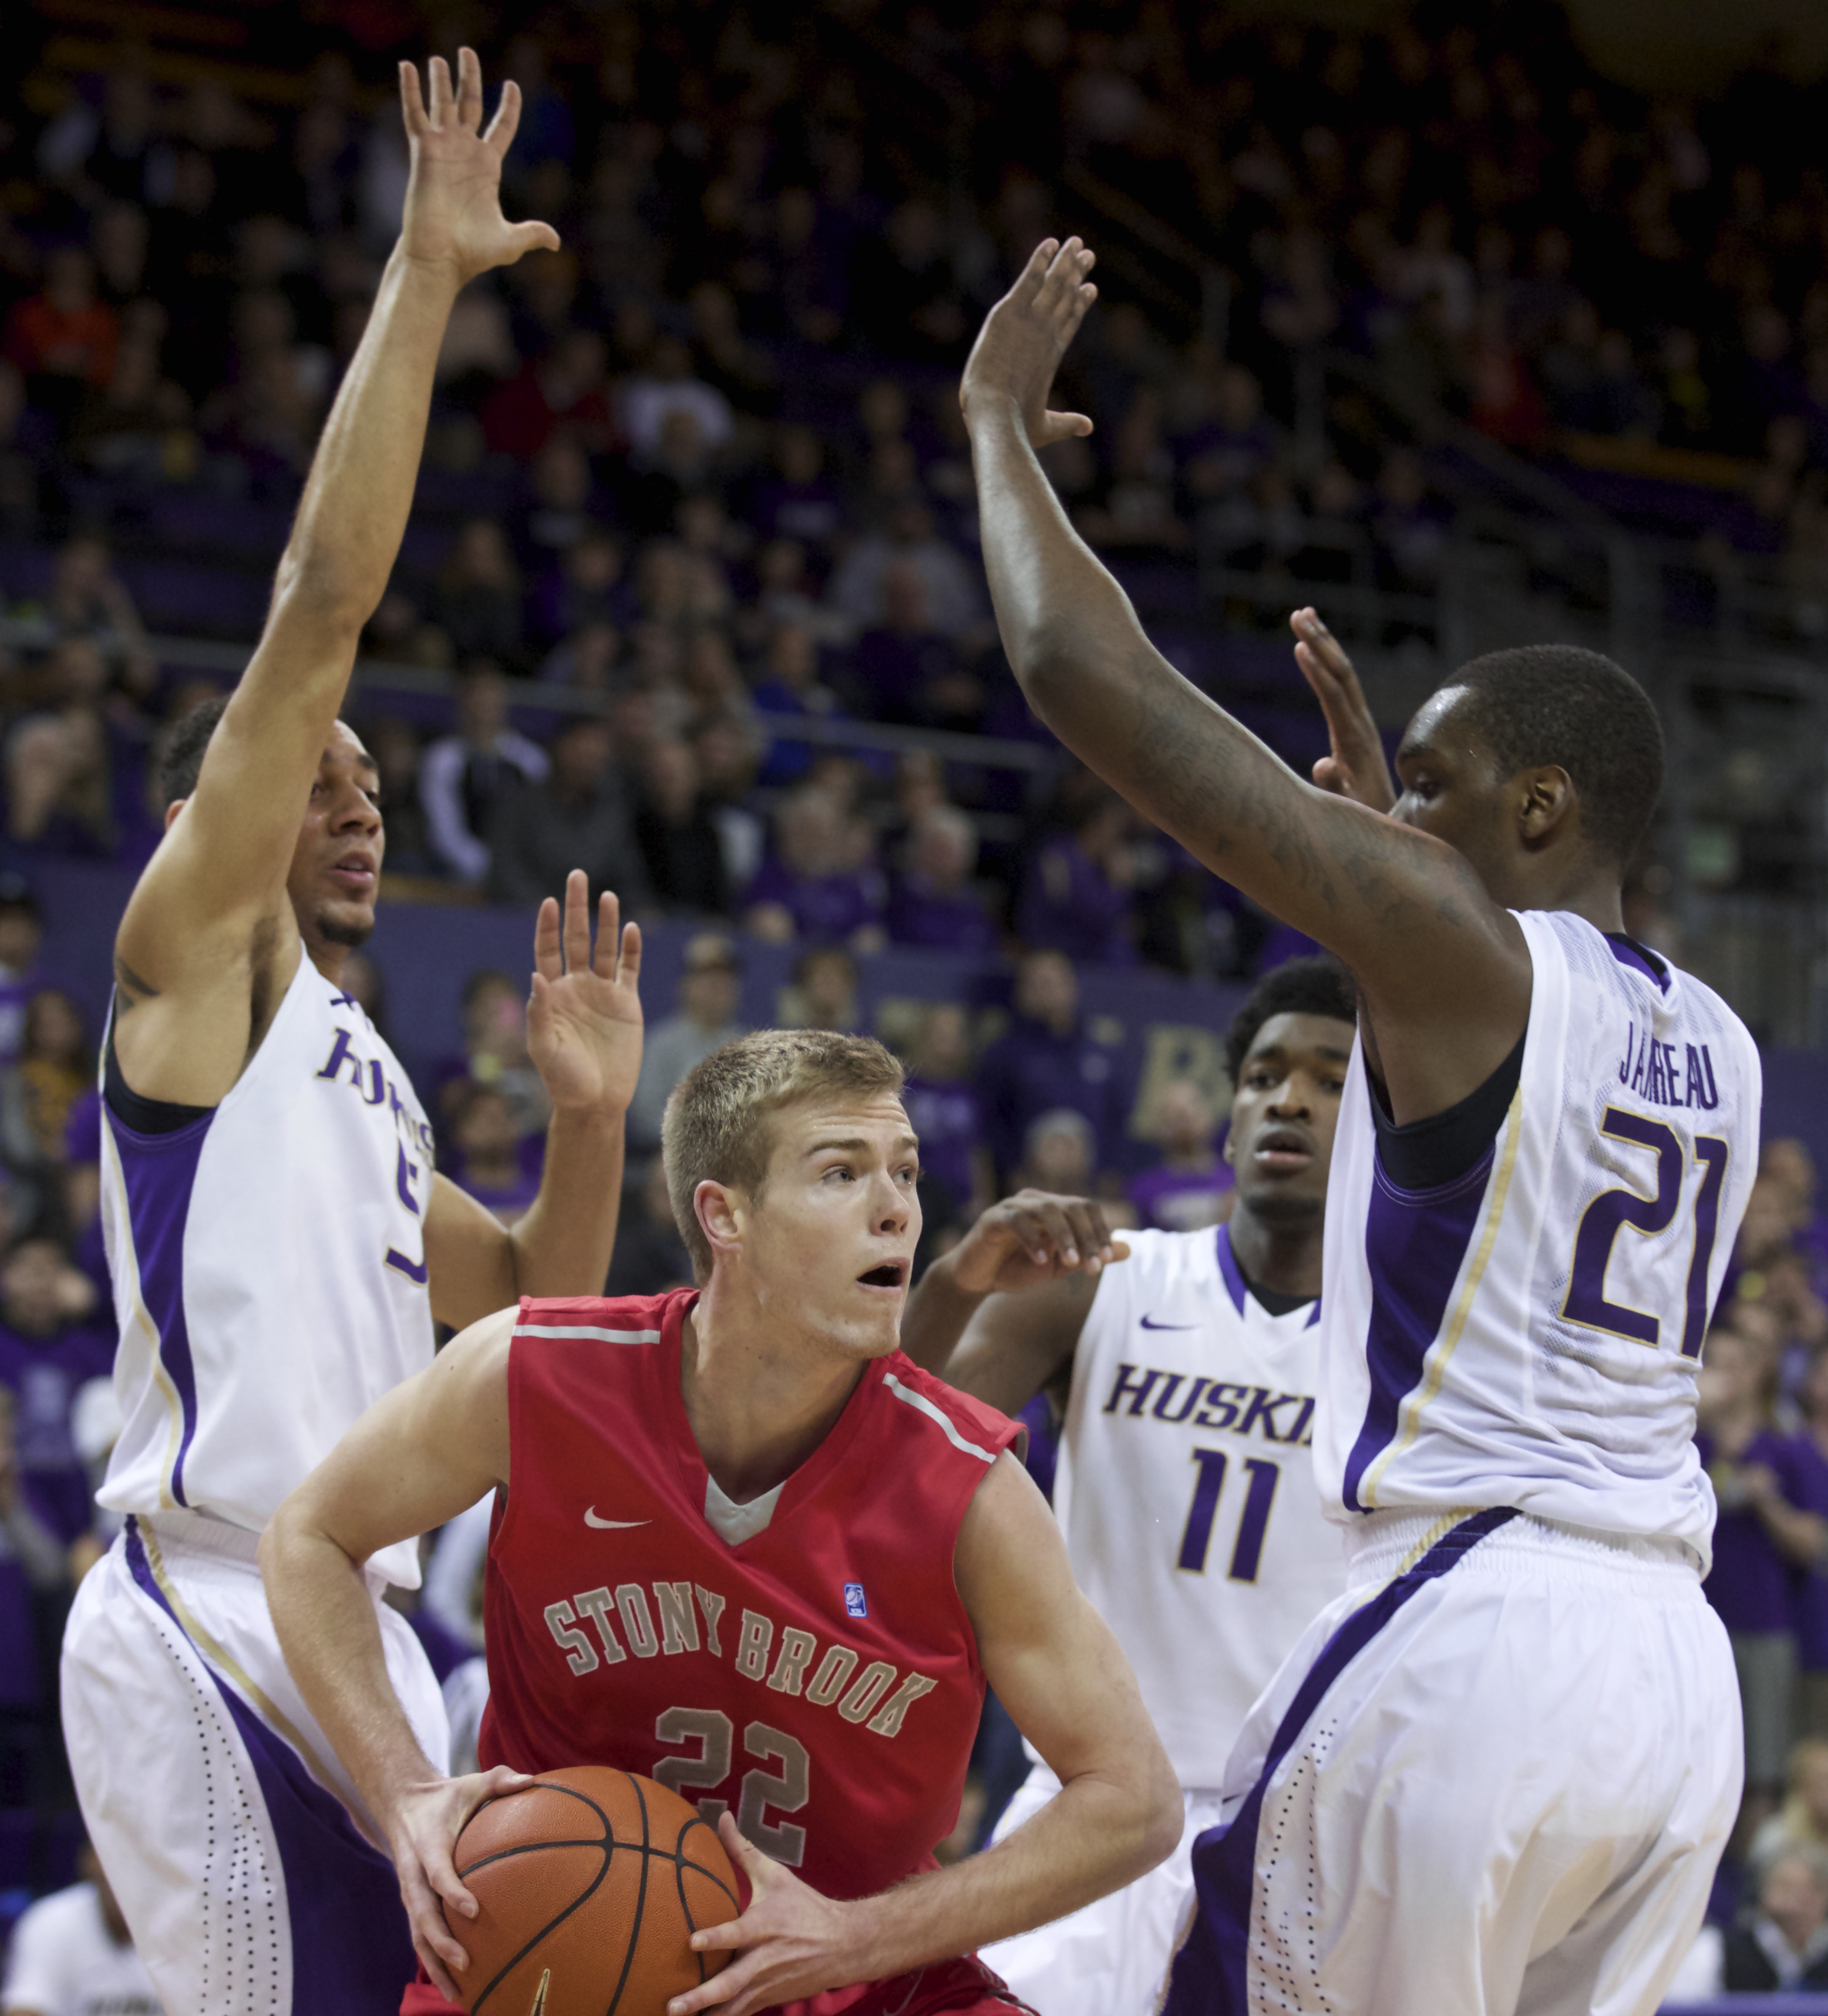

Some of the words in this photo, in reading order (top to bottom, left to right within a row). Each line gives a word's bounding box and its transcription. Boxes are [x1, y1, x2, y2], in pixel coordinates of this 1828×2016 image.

[1557, 1103, 1729, 1362] 21
[1102, 1362, 1316, 1448] HUSKI
[1176, 1445, 1281, 1586] 11
[544, 1581, 726, 1677] STONY
[735, 1608, 938, 1738] BROOK
[652, 1707, 810, 1868] 22
